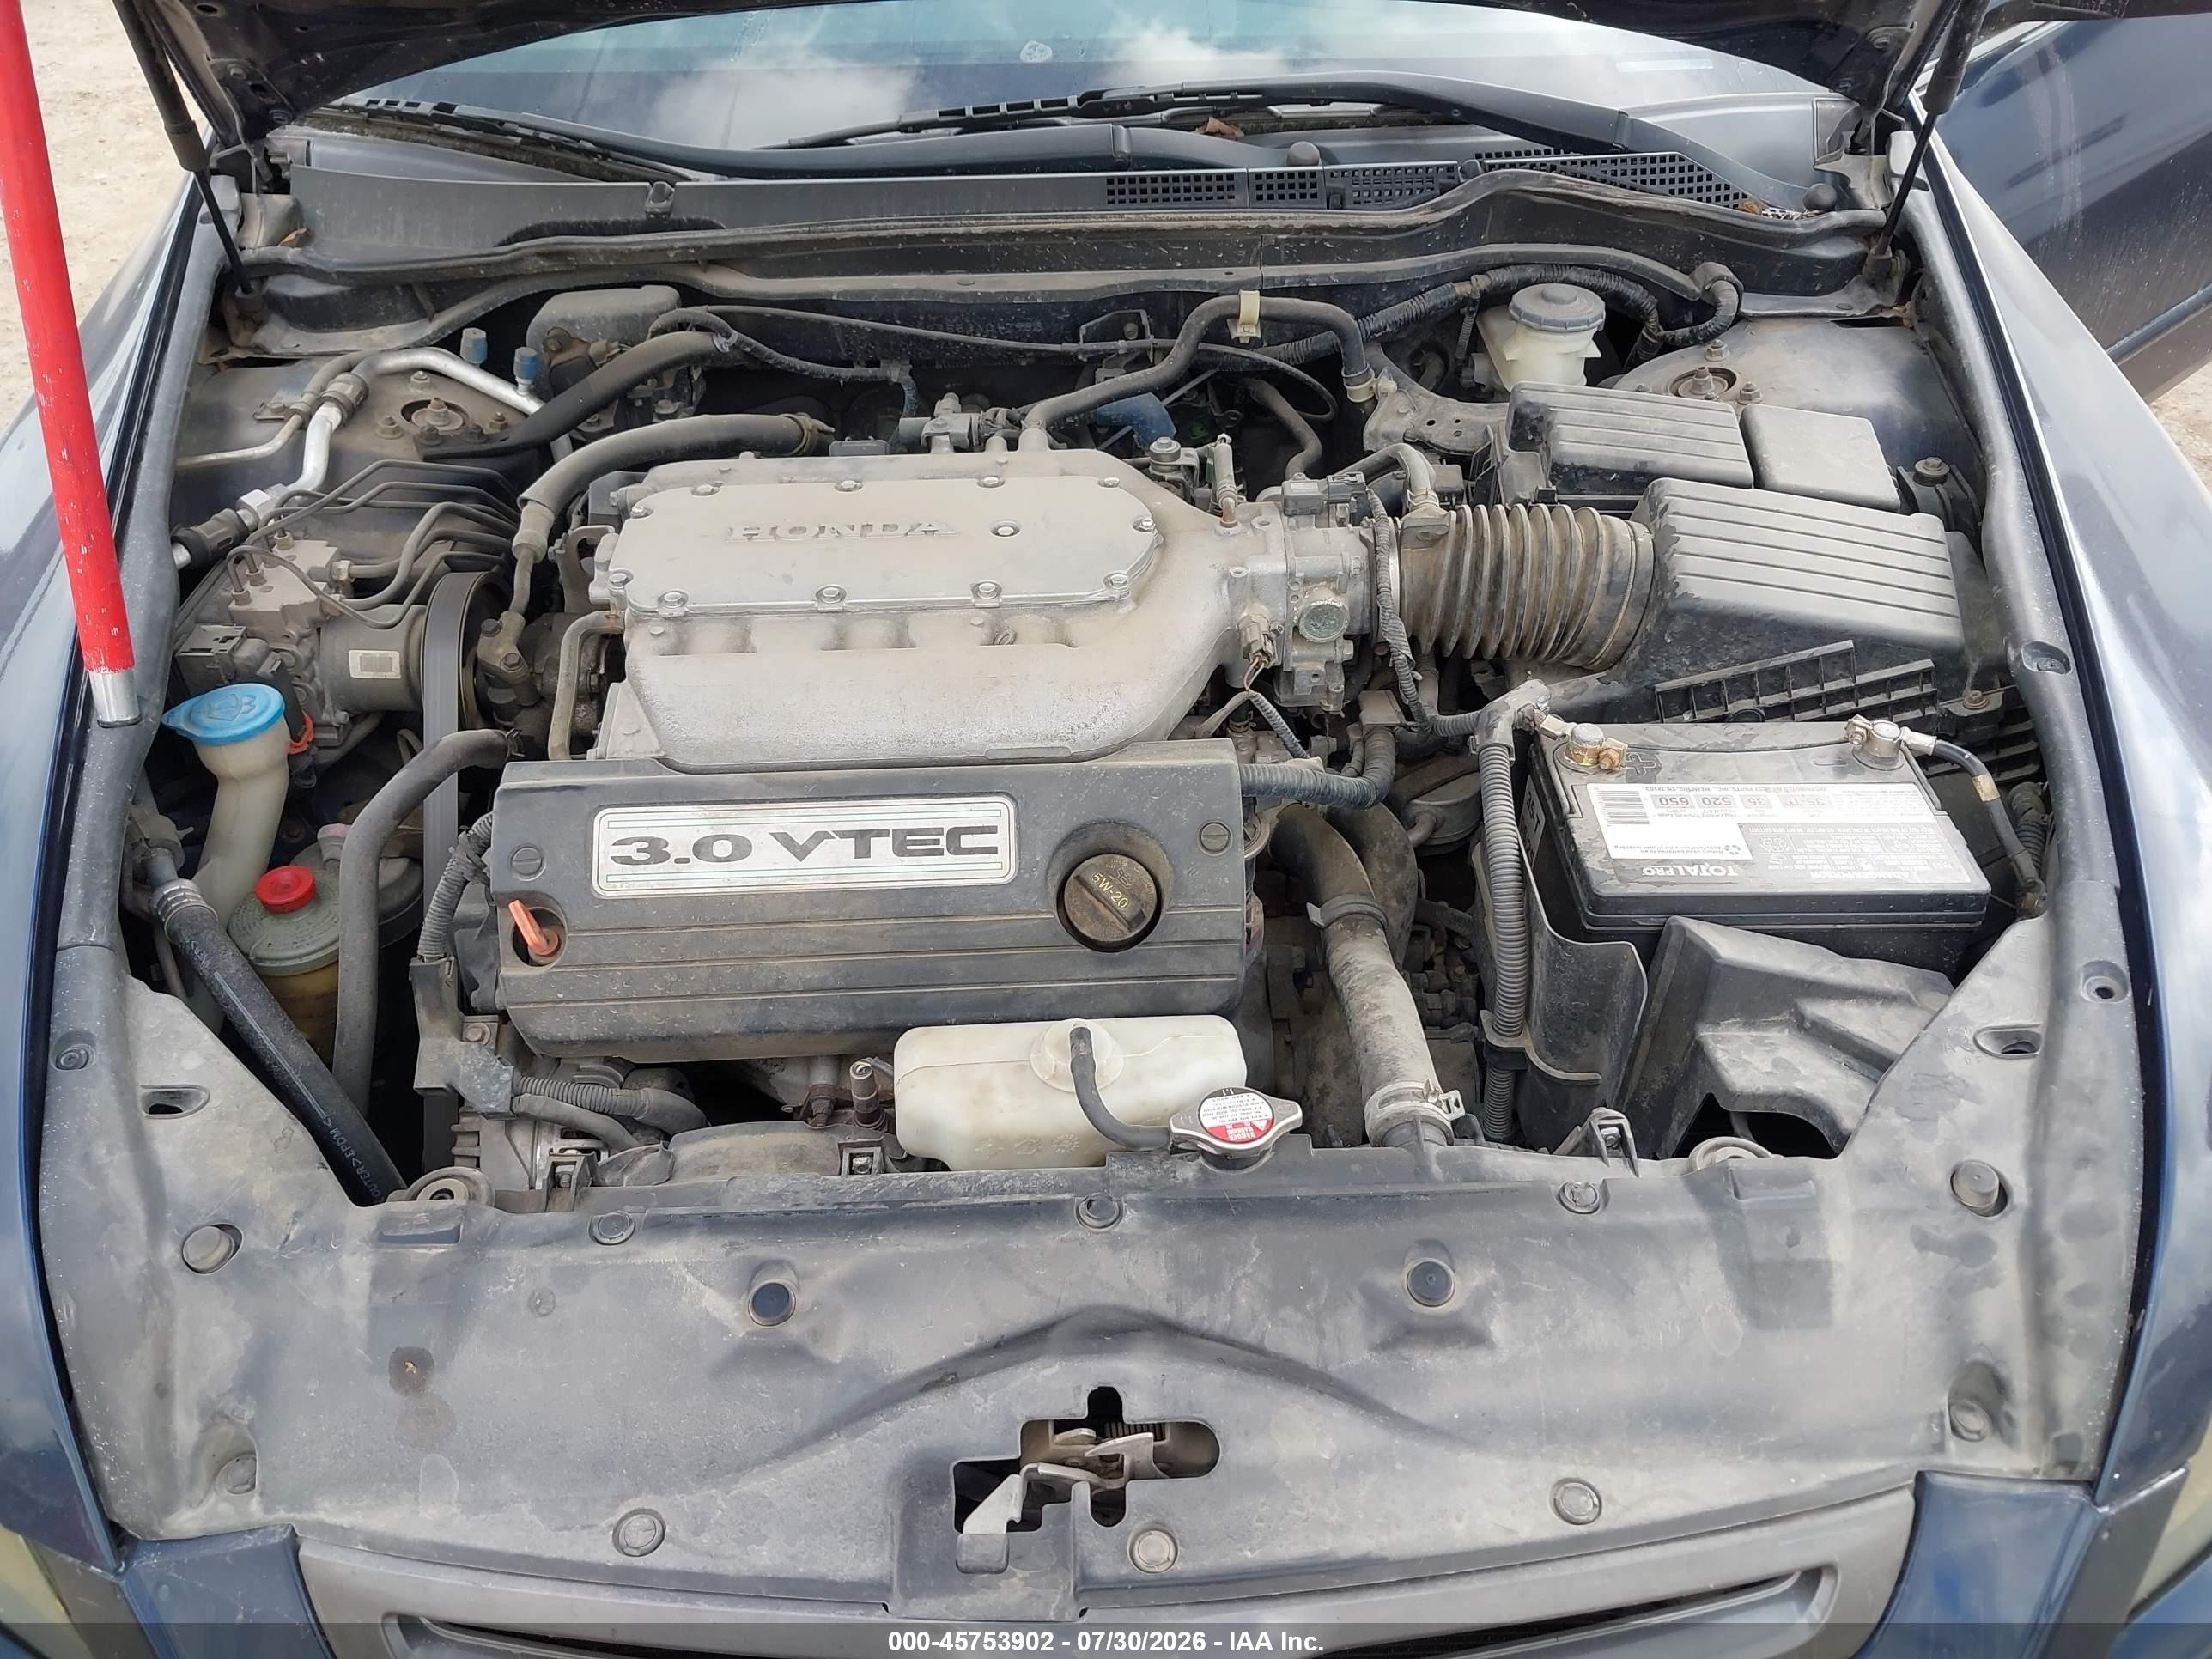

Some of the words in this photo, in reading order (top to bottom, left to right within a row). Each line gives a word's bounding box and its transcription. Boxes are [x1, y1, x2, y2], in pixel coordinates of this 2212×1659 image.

[725, 521, 960, 543] HONDA
[1658, 796, 1690, 806] 650
[1701, 796, 1732, 806] 520
[1747, 797, 1766, 806] 35
[611, 833, 753, 866] 3.0
[769, 825, 998, 863] VTEC
[1641, 865, 1739, 877] TOTALPRO
[1091, 872, 1128, 909] 5W-20
[1222, 1087, 1235, 1097] 1.1
